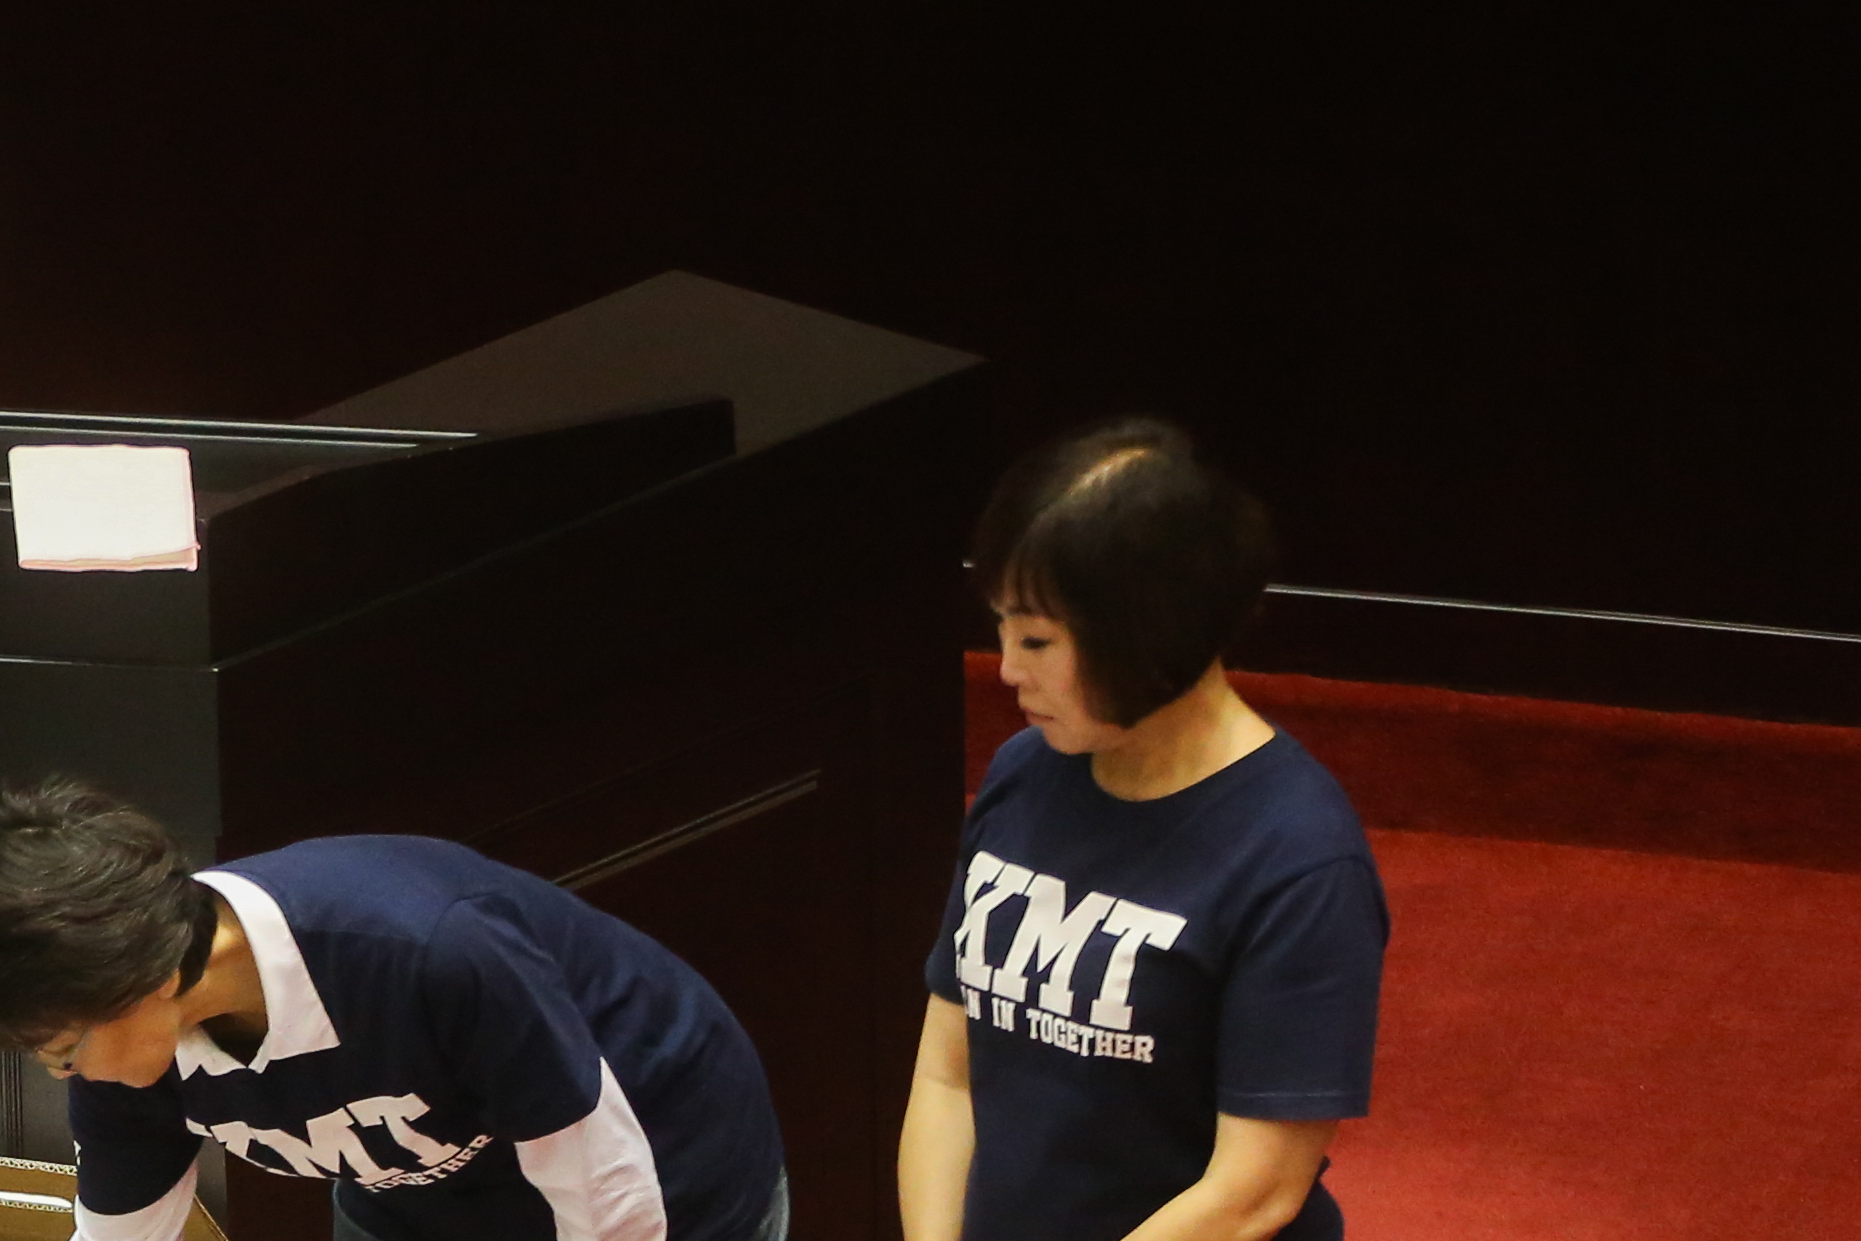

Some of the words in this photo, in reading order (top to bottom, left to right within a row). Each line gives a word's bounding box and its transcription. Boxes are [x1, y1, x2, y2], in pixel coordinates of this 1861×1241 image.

[954, 851, 1188, 1031] KMT
[991, 997, 1016, 1032] IN
[1025, 1007, 1155, 1063] TOGETHER
